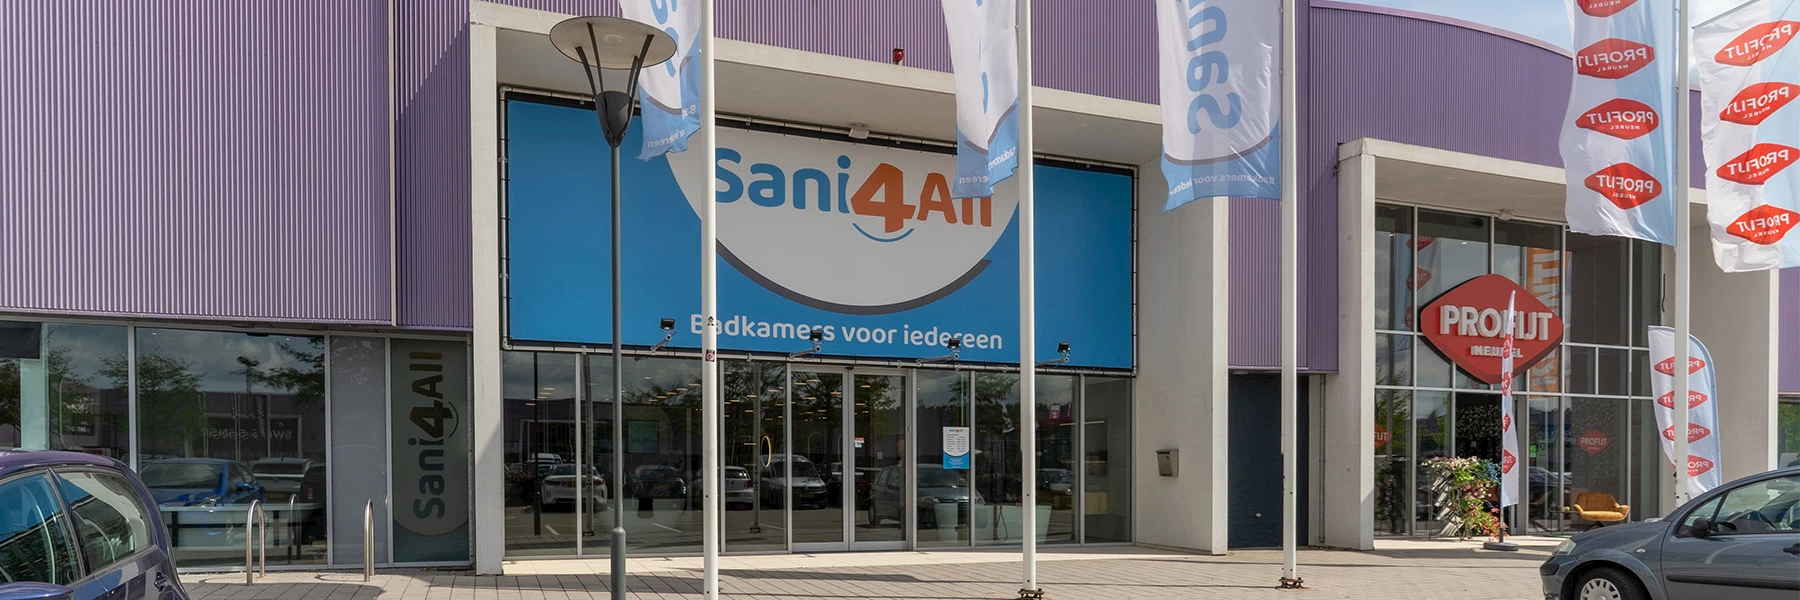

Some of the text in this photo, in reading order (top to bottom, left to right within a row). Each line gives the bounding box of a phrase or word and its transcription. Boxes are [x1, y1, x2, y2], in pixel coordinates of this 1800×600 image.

[842, 326, 898, 344] voor
[904, 324, 1003, 350] iedeeen
[1471, 345, 1523, 358] MEUEL
[408, 351, 453, 520] Sani4All
[1580, 437, 1607, 446] PROFIJT
